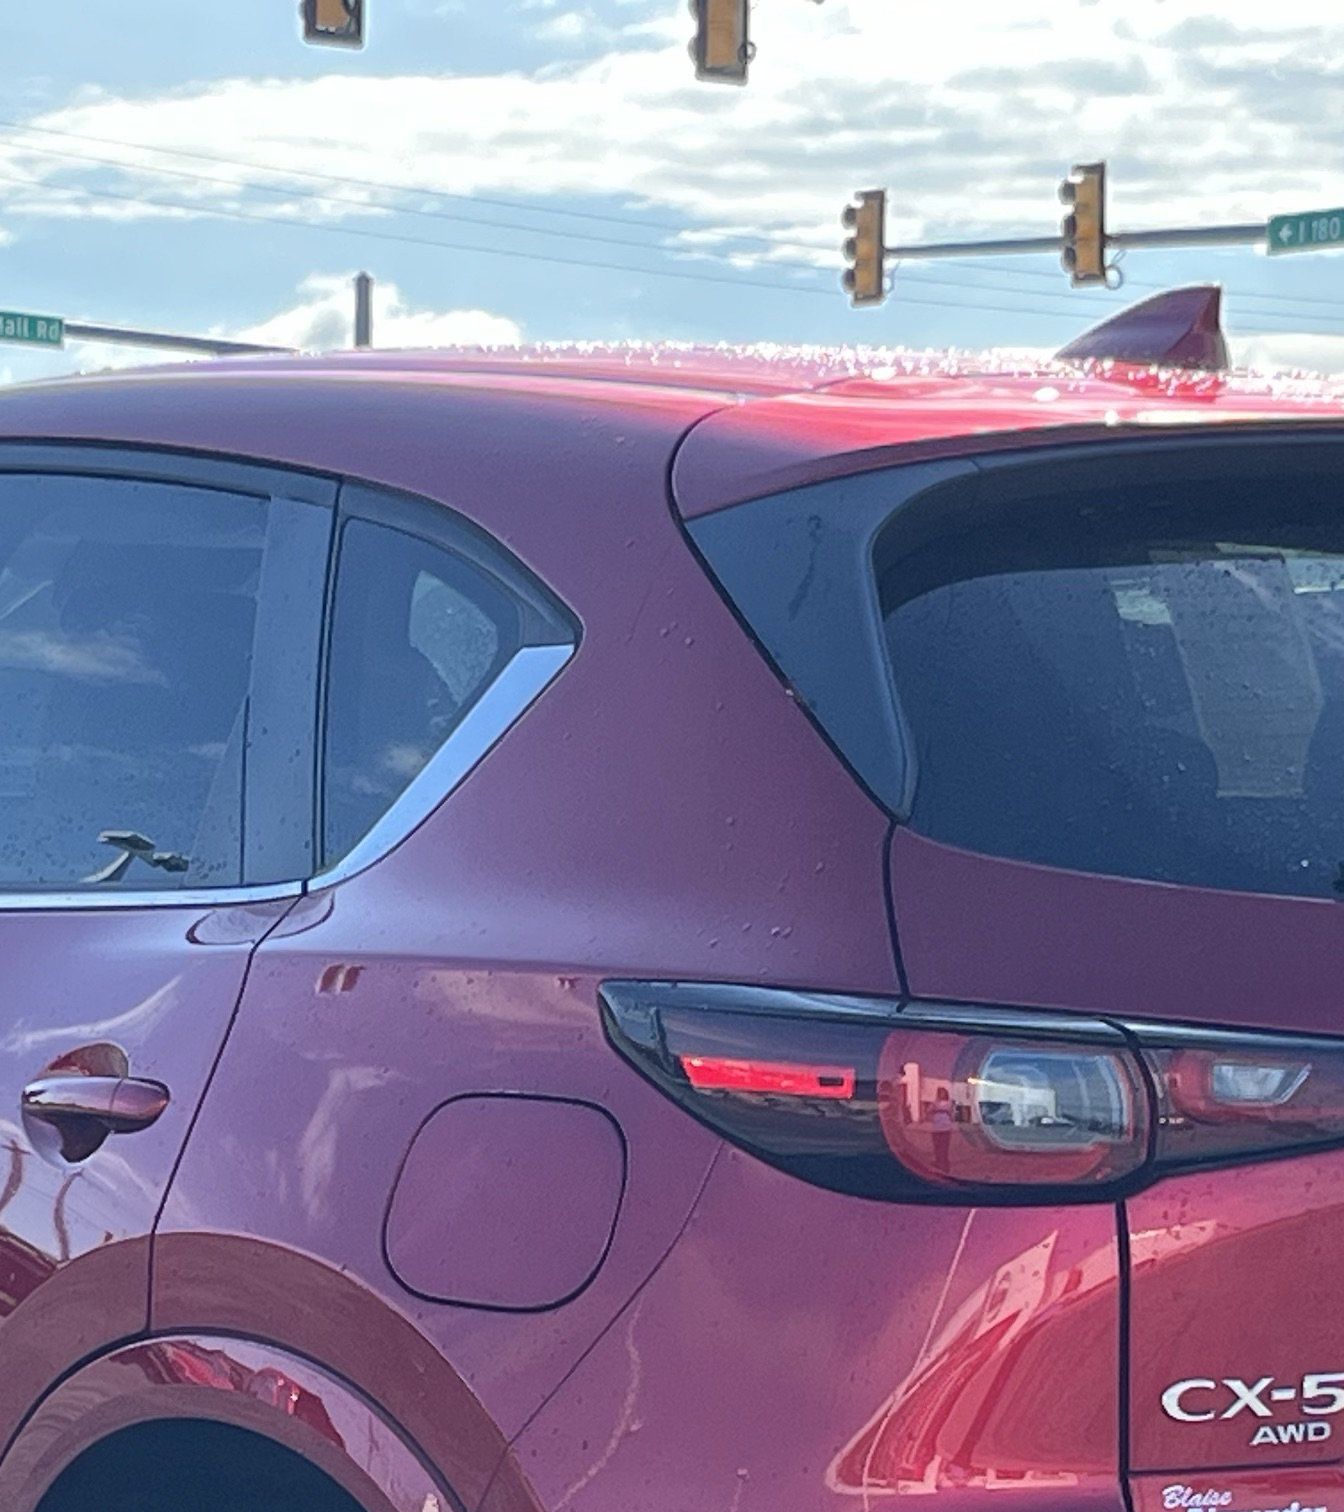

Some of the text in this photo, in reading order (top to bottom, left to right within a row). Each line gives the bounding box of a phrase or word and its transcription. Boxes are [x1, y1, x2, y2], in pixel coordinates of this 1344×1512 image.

[1299, 221, 1305, 242] I
[1311, 217, 1340, 241] 180
[37, 320, 59, 339] Rd
[1248, 1421, 1331, 1446] AWD
[1162, 1484, 1232, 1509] Blaise
